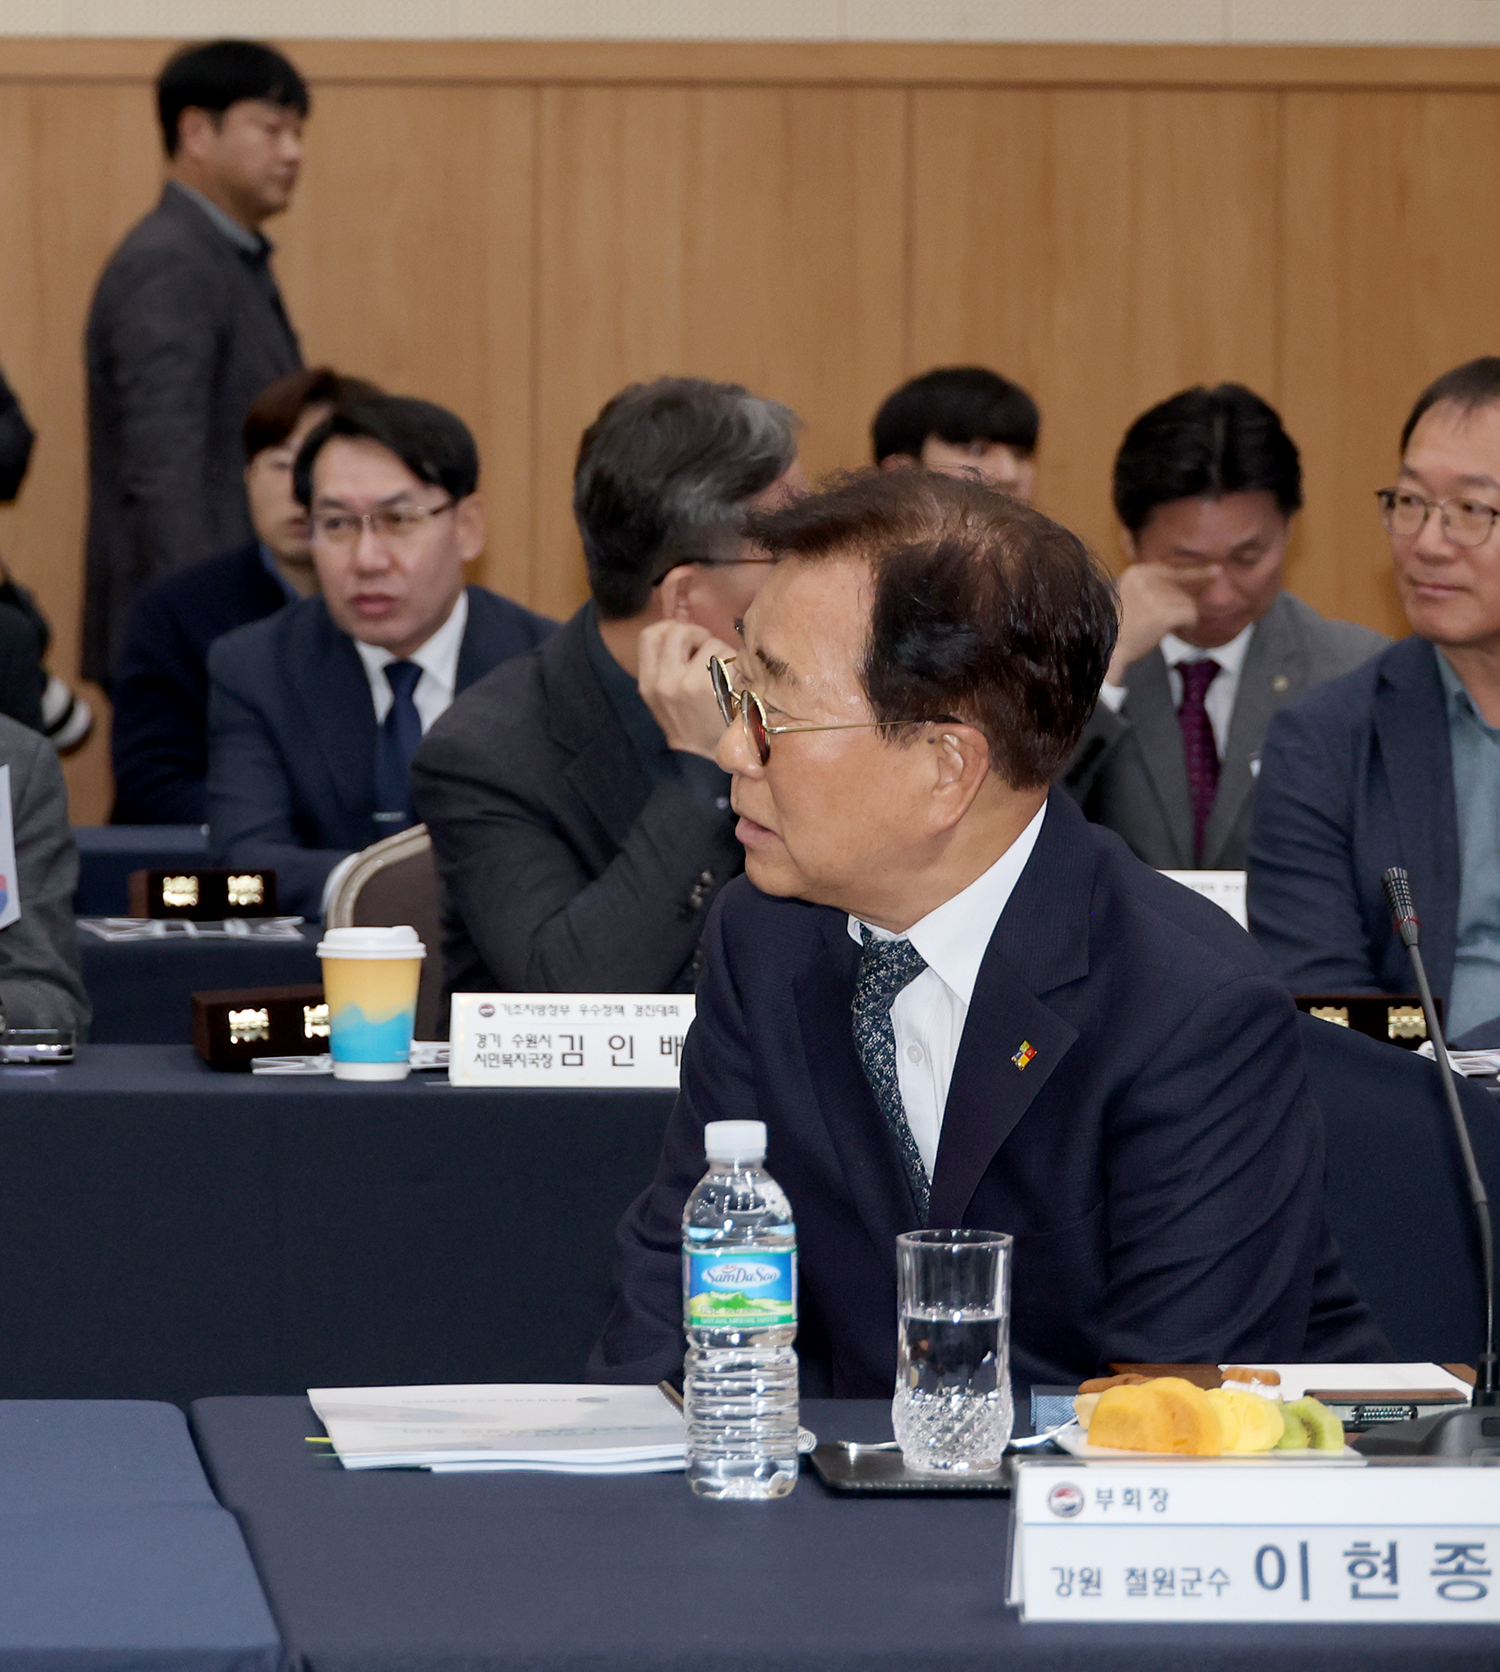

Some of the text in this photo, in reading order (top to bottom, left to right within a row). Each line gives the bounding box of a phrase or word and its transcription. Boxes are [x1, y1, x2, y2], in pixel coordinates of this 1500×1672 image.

[474, 1032, 553, 1049] 경기 수원시
[474, 1052, 553, 1069] 시민복지국장
[706, 1266, 778, 1284] SamDaSoo
[1050, 1566, 1103, 1598] 강원
[1124, 1566, 1231, 1598] 철원군수
